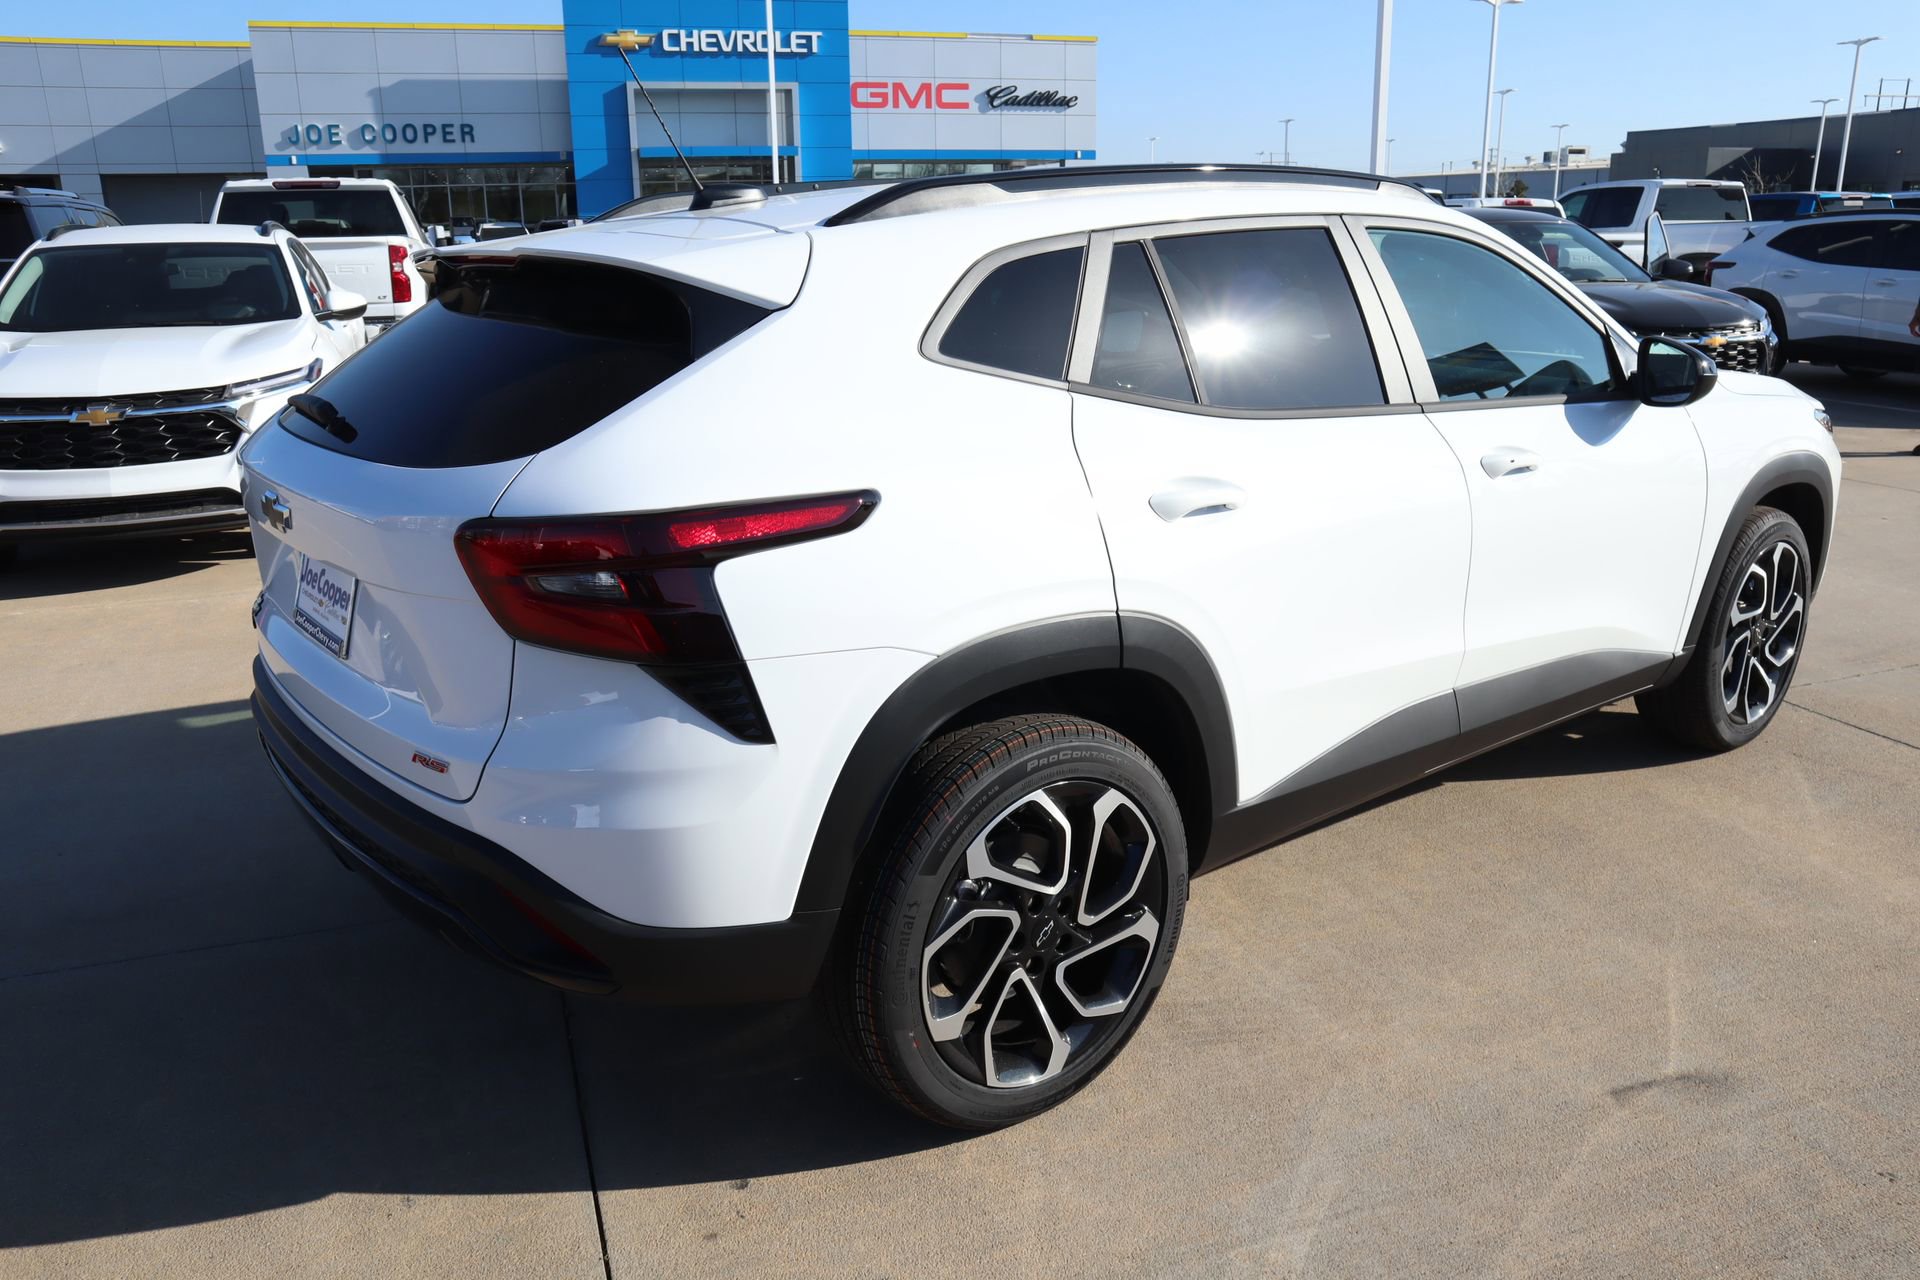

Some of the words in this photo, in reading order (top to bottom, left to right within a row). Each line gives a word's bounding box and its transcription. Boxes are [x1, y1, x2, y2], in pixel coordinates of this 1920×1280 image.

[662, 29, 823, 53] CHEVROLET
[850, 81, 970, 110] GMC
[985, 85, 1079, 109] Cadillac
[287, 123, 343, 146] JOE
[359, 123, 476, 145] COOPER
[411, 751, 450, 774] RS
